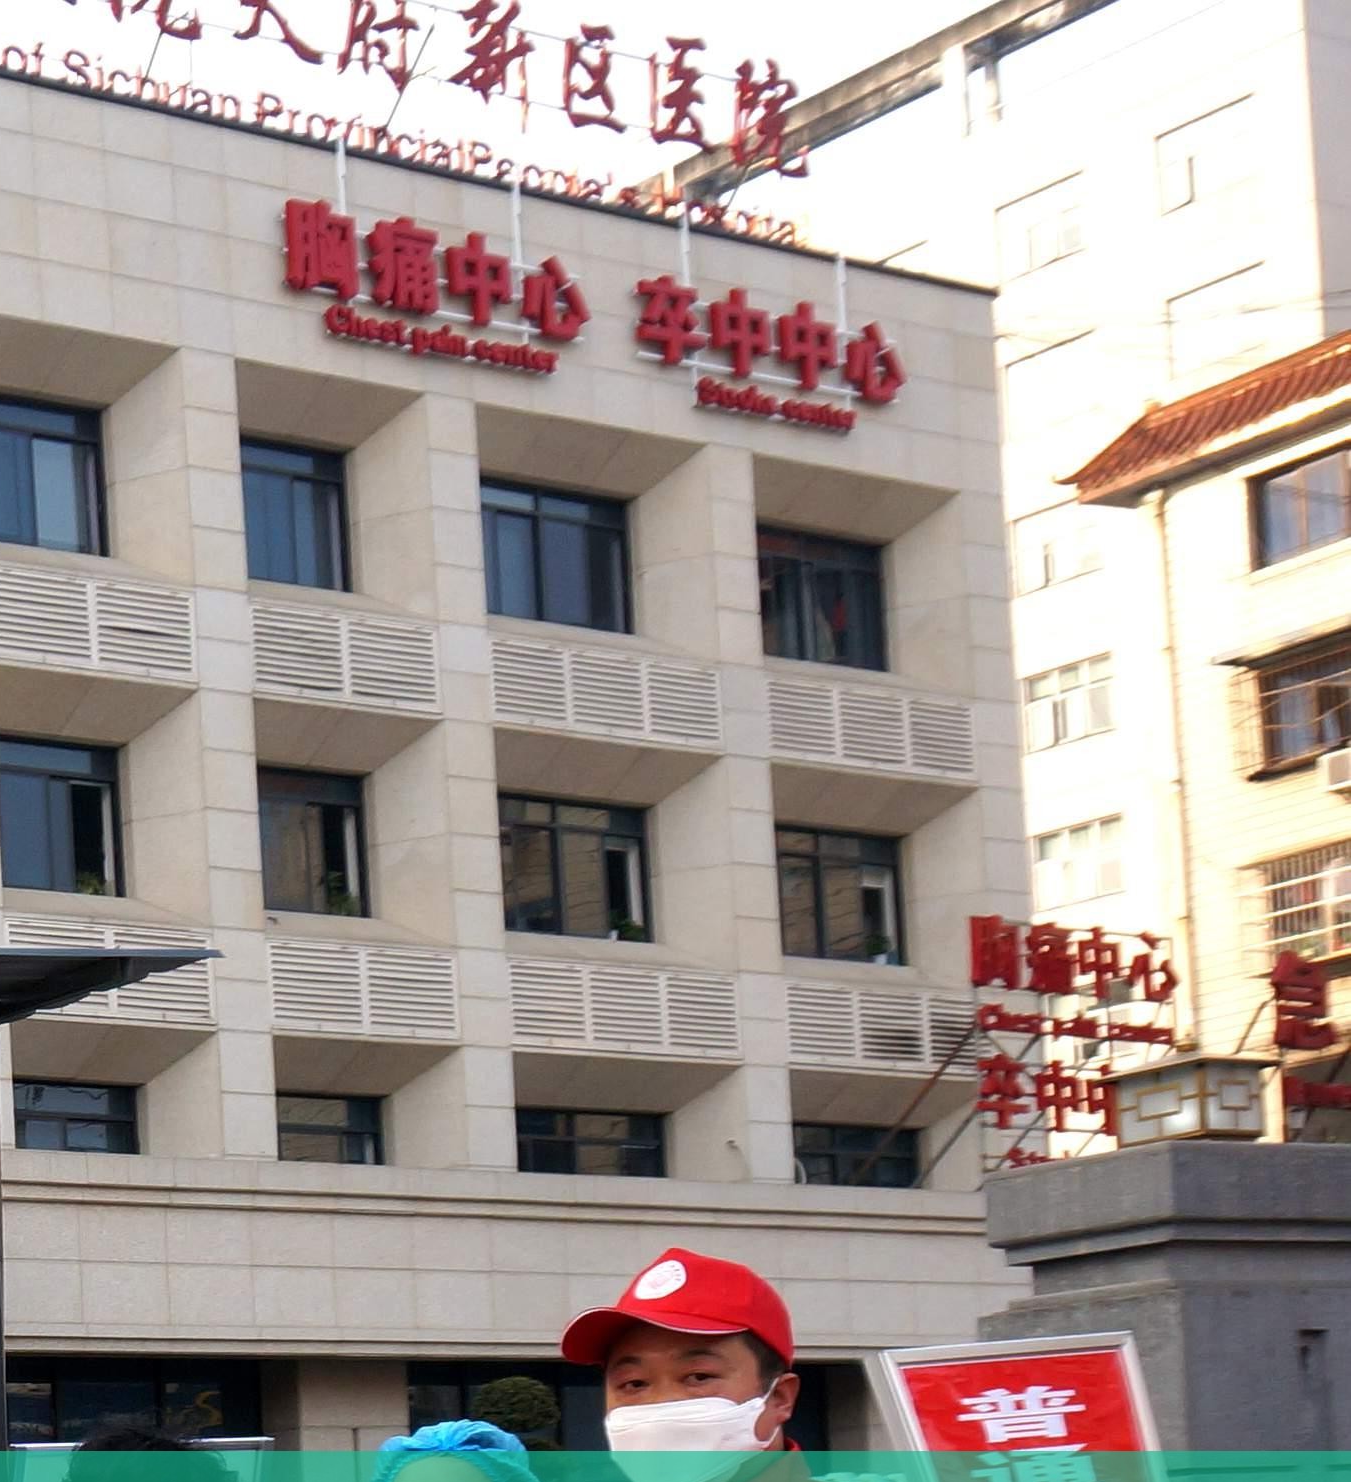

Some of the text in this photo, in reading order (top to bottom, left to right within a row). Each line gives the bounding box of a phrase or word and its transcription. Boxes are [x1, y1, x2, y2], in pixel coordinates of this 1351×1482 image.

[1, 41, 45, 77] of
[283, 197, 589, 341] 胸痛中心
[635, 274, 908, 404] 卒中中心
